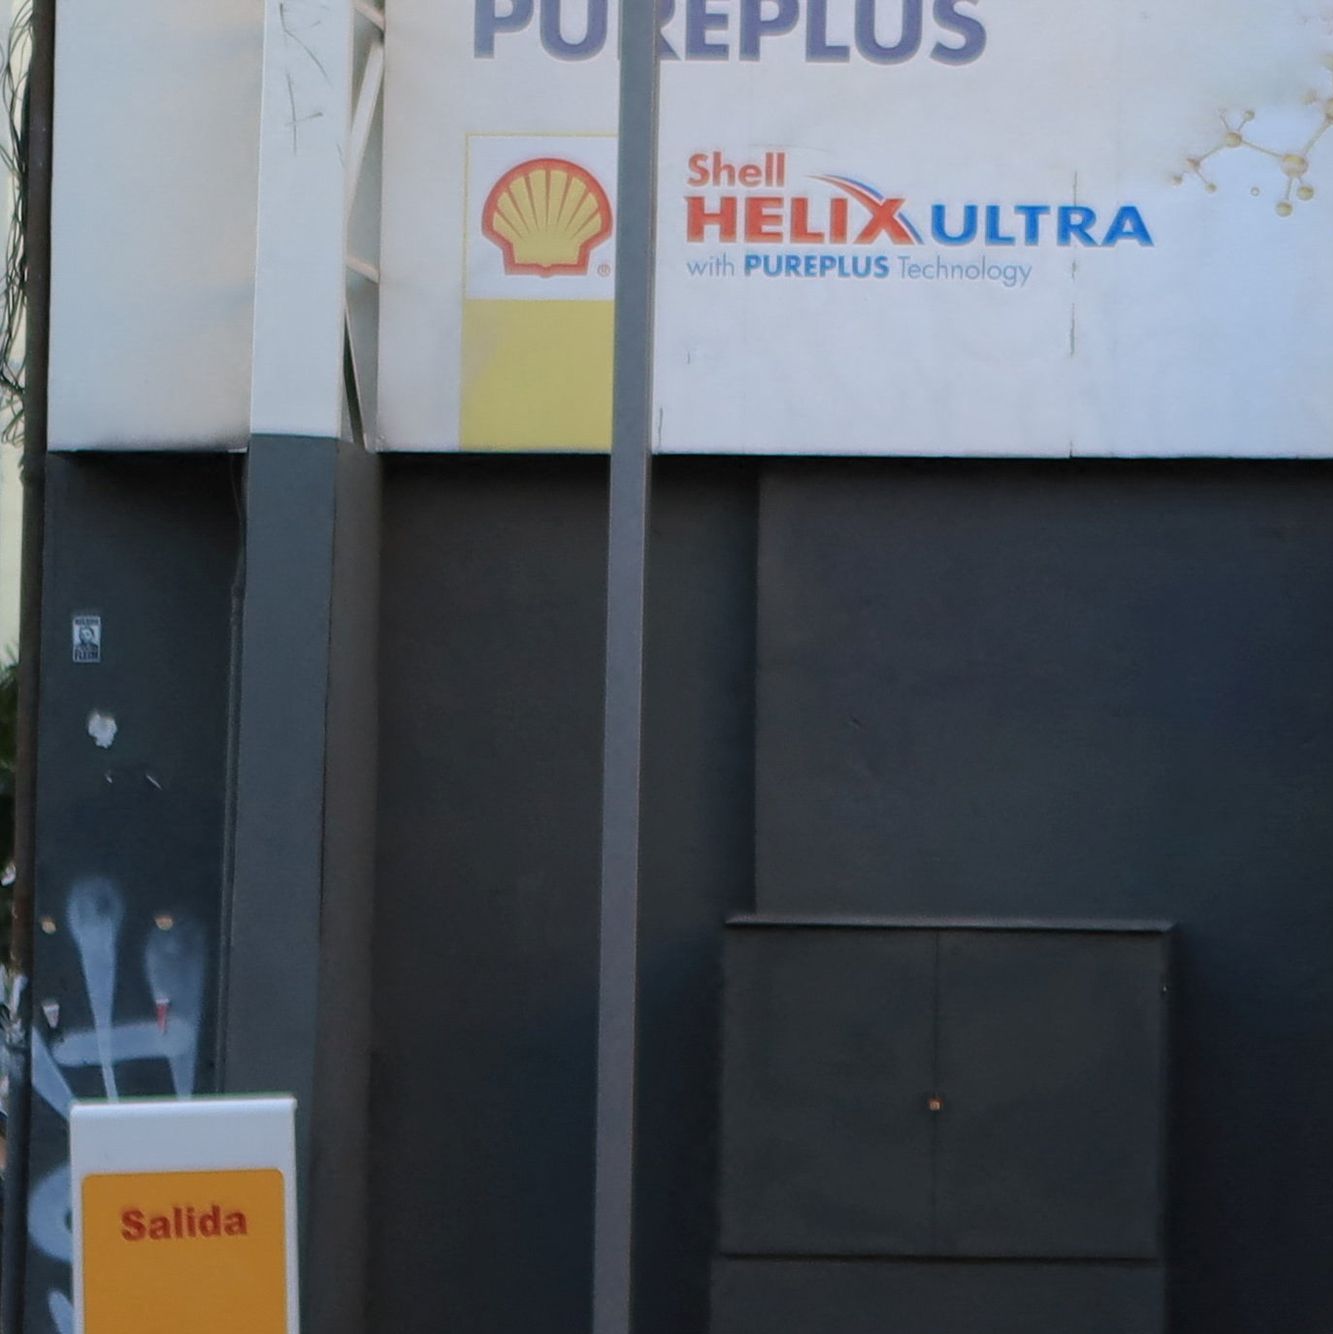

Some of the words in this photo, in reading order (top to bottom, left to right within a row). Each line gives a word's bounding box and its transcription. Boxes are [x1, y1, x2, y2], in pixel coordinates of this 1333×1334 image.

[688, 152, 785, 188] Shell
[685, 195, 921, 245] HELIX
[931, 204, 1154, 247] ULTRA
[687, 255, 735, 278] with
[743, 254, 890, 279] PUREPLUS
[898, 256, 1032, 288] Technology
[121, 1204, 248, 1241] Salida
